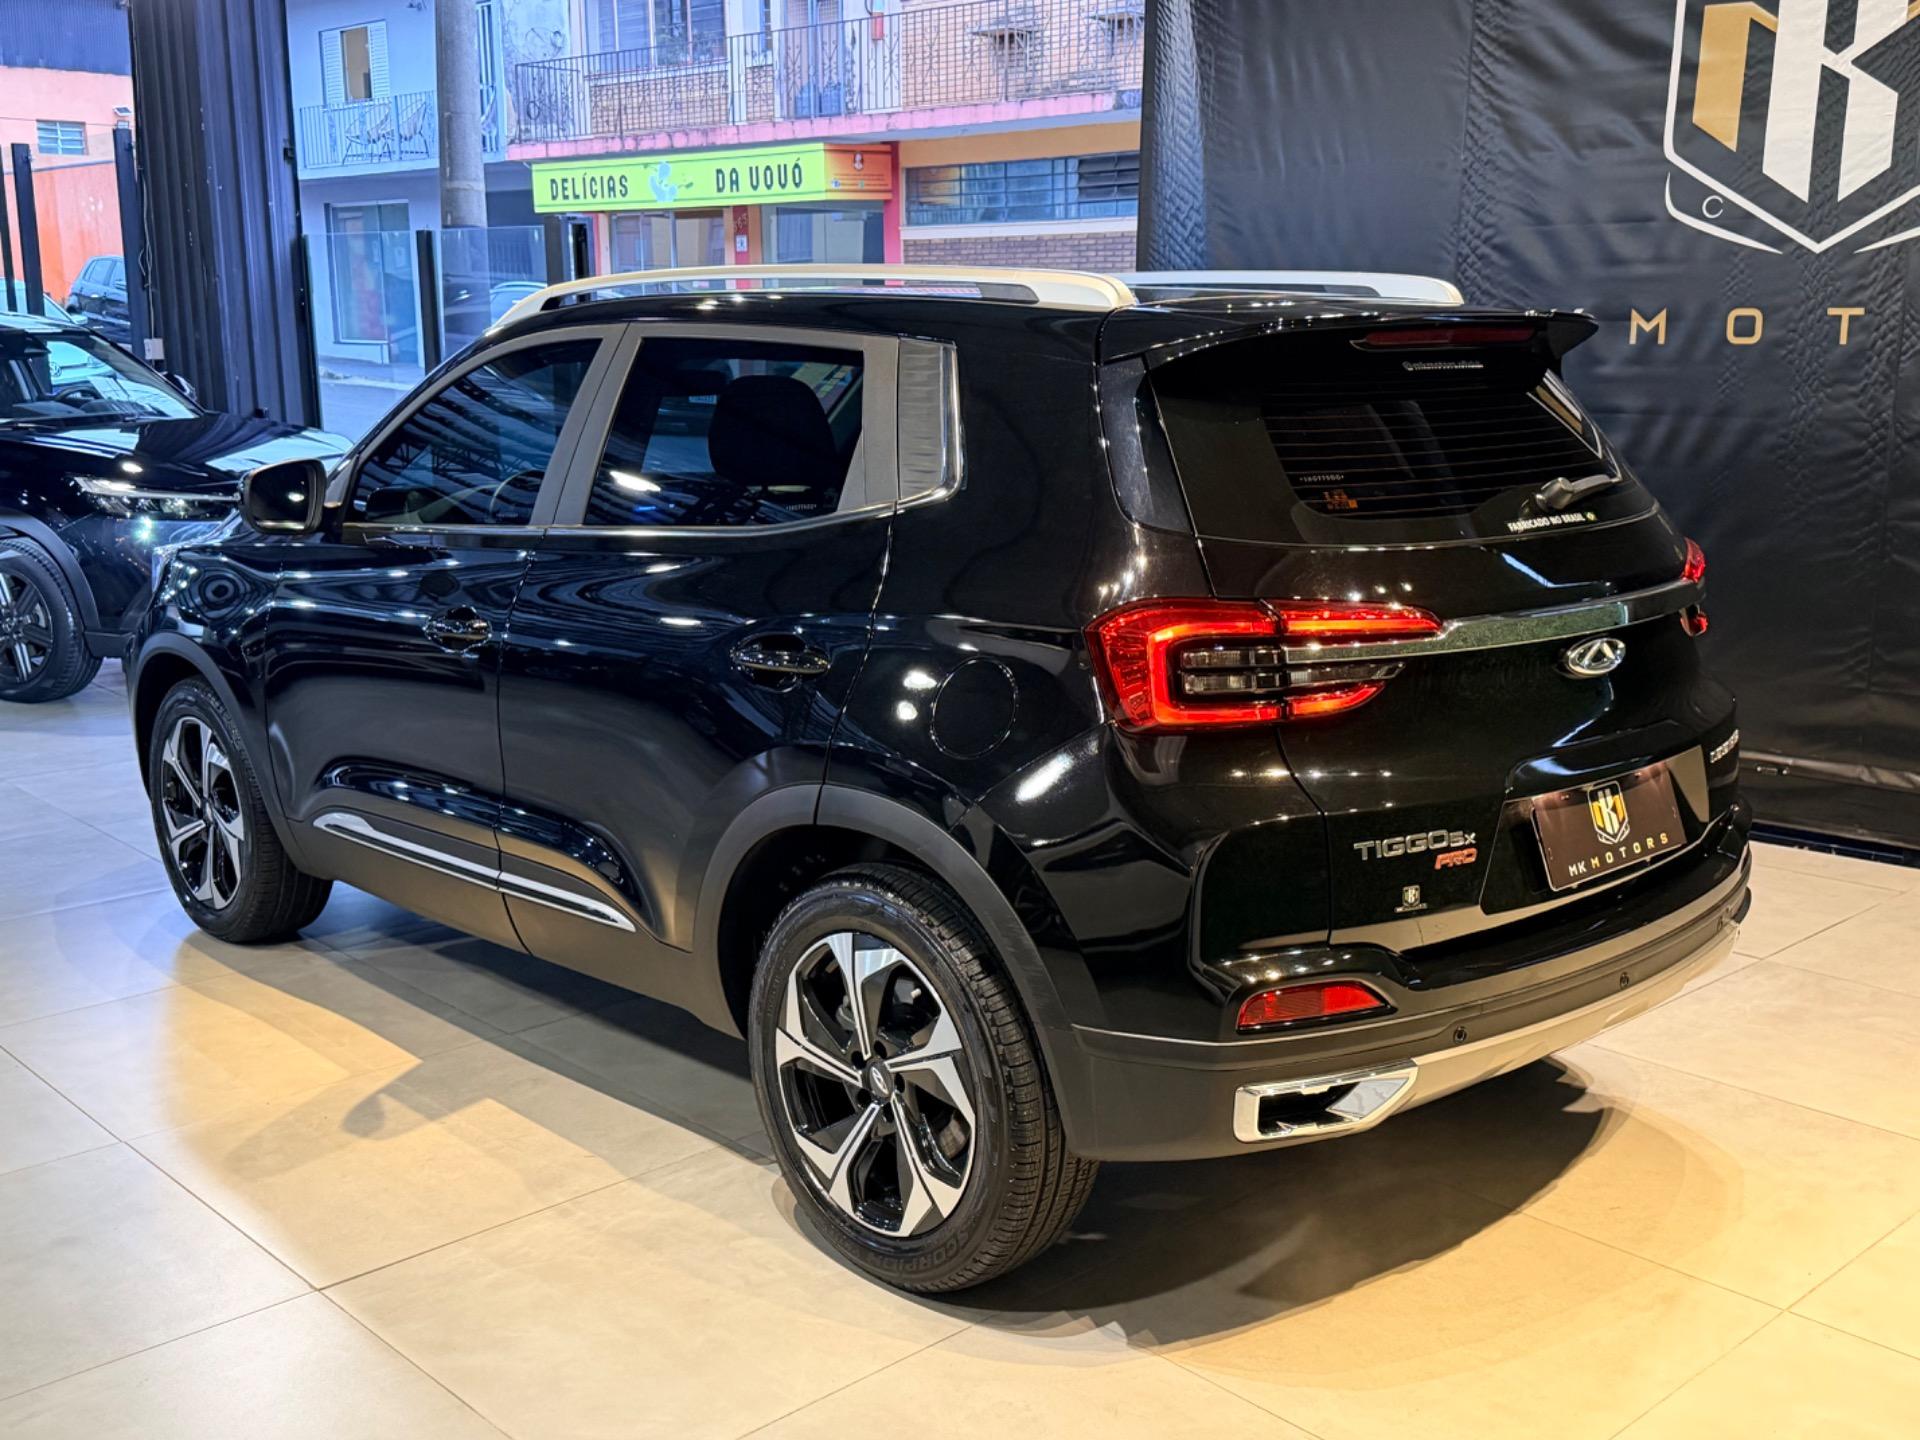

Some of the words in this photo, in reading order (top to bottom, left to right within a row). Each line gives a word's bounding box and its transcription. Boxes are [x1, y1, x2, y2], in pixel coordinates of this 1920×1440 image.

[550, 173, 629, 201] DELÍCIAS
[715, 167, 740, 193] DA
[1434, 847, 1478, 870] PRO
[1568, 859, 1587, 877] MK
[1590, 832, 1669, 869] MOTORS
